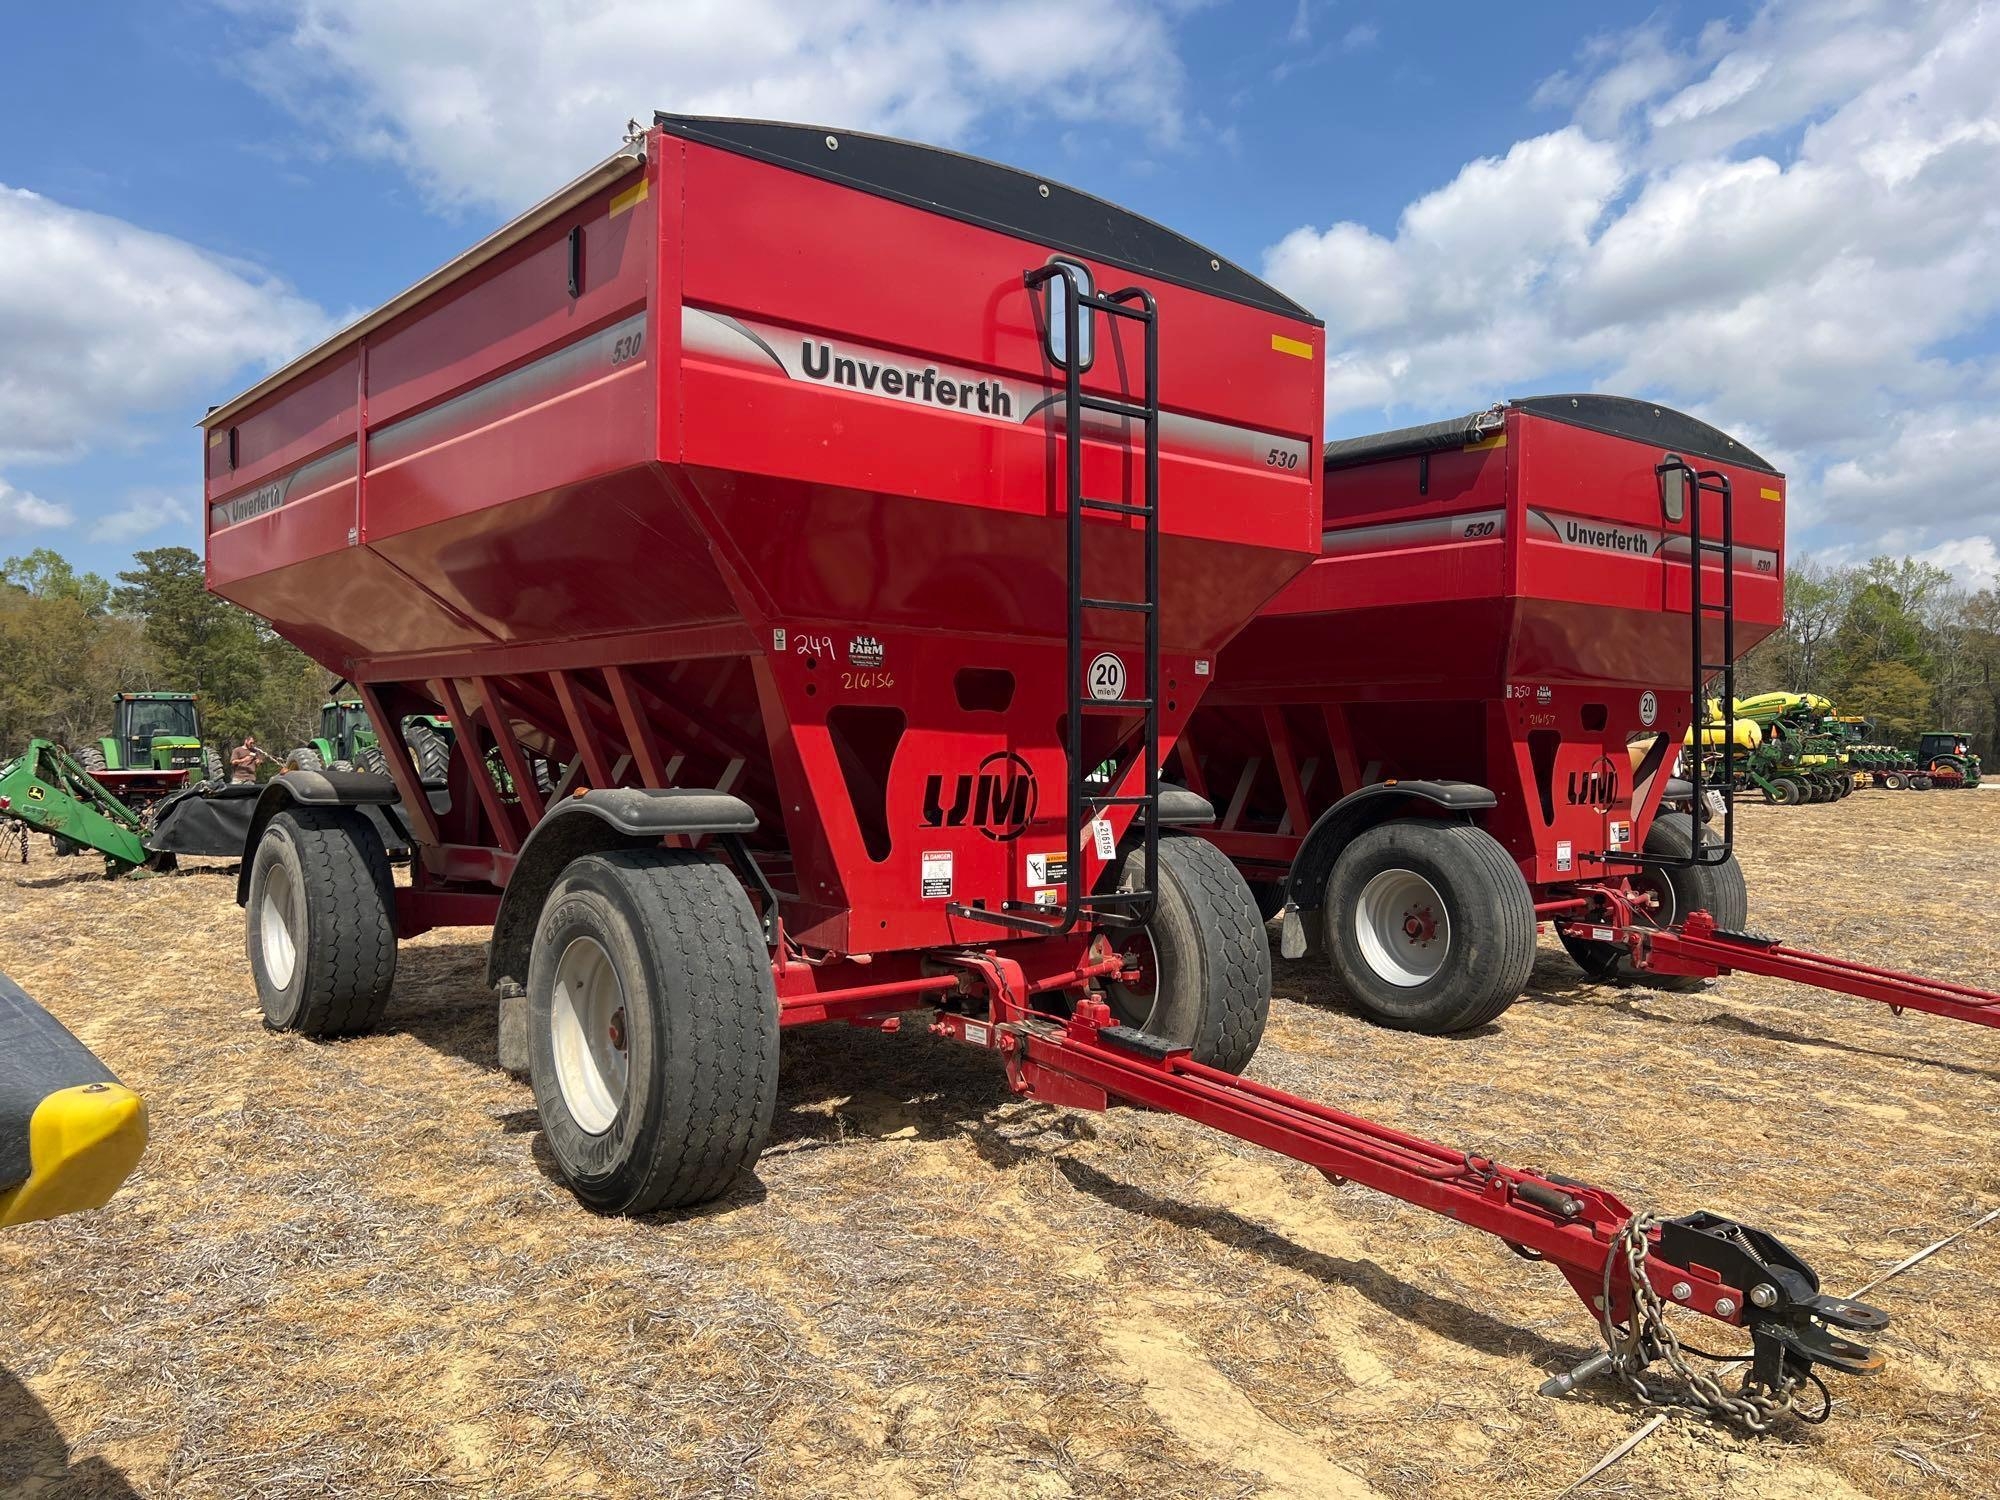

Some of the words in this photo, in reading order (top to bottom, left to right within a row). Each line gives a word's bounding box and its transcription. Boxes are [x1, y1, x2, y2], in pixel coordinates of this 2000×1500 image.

[612, 331, 642, 364] 530
[802, 341, 1012, 418] Unverferth
[1266, 448, 1298, 469] 530
[231, 484, 280, 522] Unverferth
[1464, 521, 1495, 538] 530
[1566, 521, 1648, 554] Unverferth
[1757, 559, 1771, 571] 530
[793, 634, 836, 661] 249
[848, 641, 884, 655] FARM
[841, 672, 895, 690] 216156
[1096, 664, 1118, 686] 20
[1514, 685, 1531, 698] 250
[1643, 698, 1654, 712] 20
[1529, 714, 1556, 725] 216157
[1100, 827, 1112, 854] 216156
